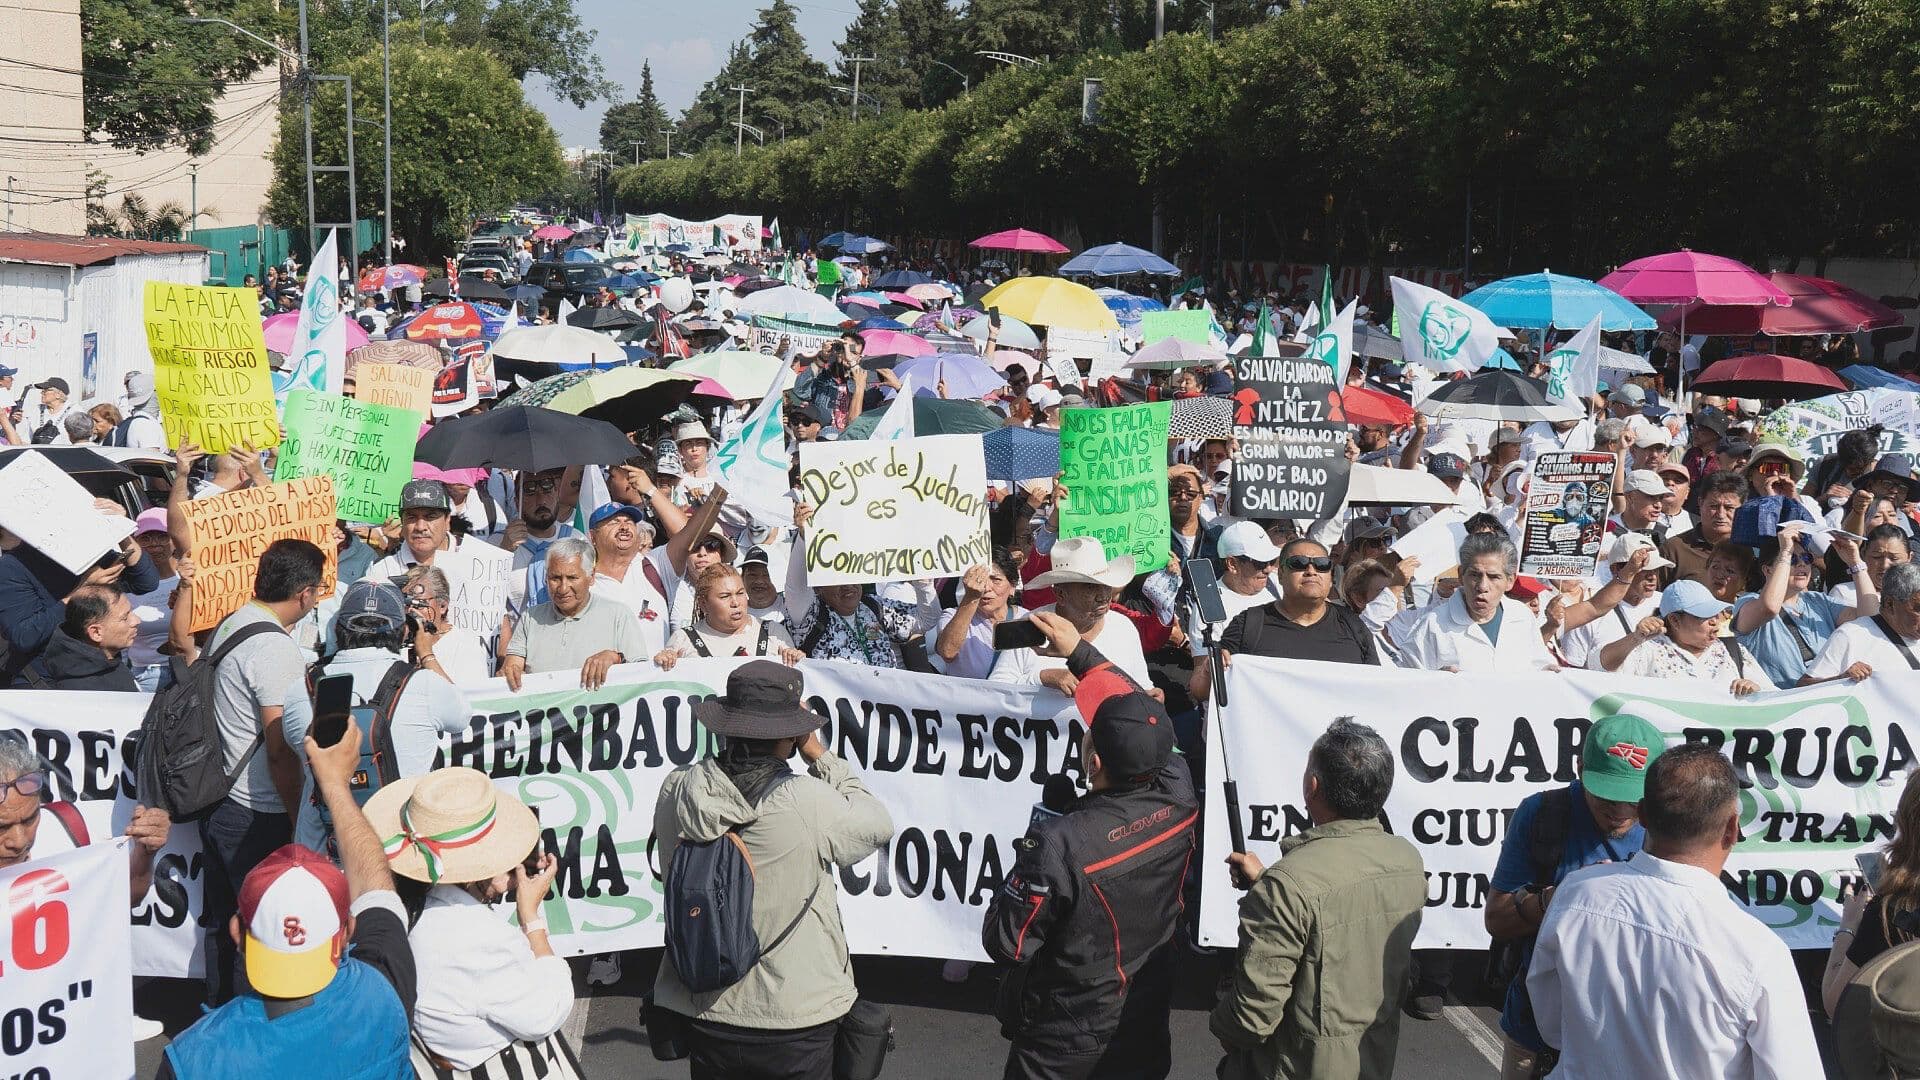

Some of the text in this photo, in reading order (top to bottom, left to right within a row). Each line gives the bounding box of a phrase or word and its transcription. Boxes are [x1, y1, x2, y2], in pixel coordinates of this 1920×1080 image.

[154, 285, 246, 320] LA FALTA
[150, 319, 254, 348] DE INSUMOS
[183, 351, 197, 368] EN
[203, 351, 257, 369] RIESGO
[1239, 359, 1334, 385] SALVAGUARDAR
[168, 370, 251, 396] LA SALUD
[370, 366, 422, 388] SALARIO
[371, 388, 412, 409] DIGNO
[1283, 386, 1303, 400] LA
[163, 397, 273, 419] DE NUESTROS
[304, 391, 390, 427] SIN PERSONAL
[1258, 398, 1324, 423] NIÑEZ
[314, 416, 383, 448] SUFICIENTE
[1064, 408, 1153, 435] NO ES FALTA
[1233, 425, 1251, 441] ES
[1253, 426, 1274, 441] UN
[1276, 426, 1333, 443] TRABAJO
[1845, 415, 1870, 430] IMSS
[285, 439, 300, 457] NO
[307, 440, 334, 460] HAY
[1063, 431, 1150, 462] DE GANAS
[1541, 455, 1557, 464] CON
[1557, 454, 1572, 464] MIS
[884, 446, 908, 478] de
[1064, 455, 1154, 481] ES FALTA DE
[1536, 461, 1614, 477] SALVAMOS AL PAÍS
[288, 482, 298, 500] A
[303, 475, 331, 496] LOS
[364, 478, 382, 496] EL
[1267, 464, 1287, 484] DE
[1291, 466, 1327, 486] BAJO
[867, 498, 897, 520] es
[1065, 480, 1159, 516] INSUMOS
[1242, 485, 1325, 519] SALARIO!
[1532, 494, 1558, 506] HOY NO
[193, 508, 268, 543] MEDICOS
[268, 503, 292, 527] DEL
[199, 533, 270, 570] QUIENES
[316, 523, 330, 544] DE
[1537, 566, 1582, 575] 2 NEURONAS
[430, 694, 726, 779] HEINBAU
[1401, 716, 1595, 784] CLAR
[1412, 808, 1518, 846] CIU
